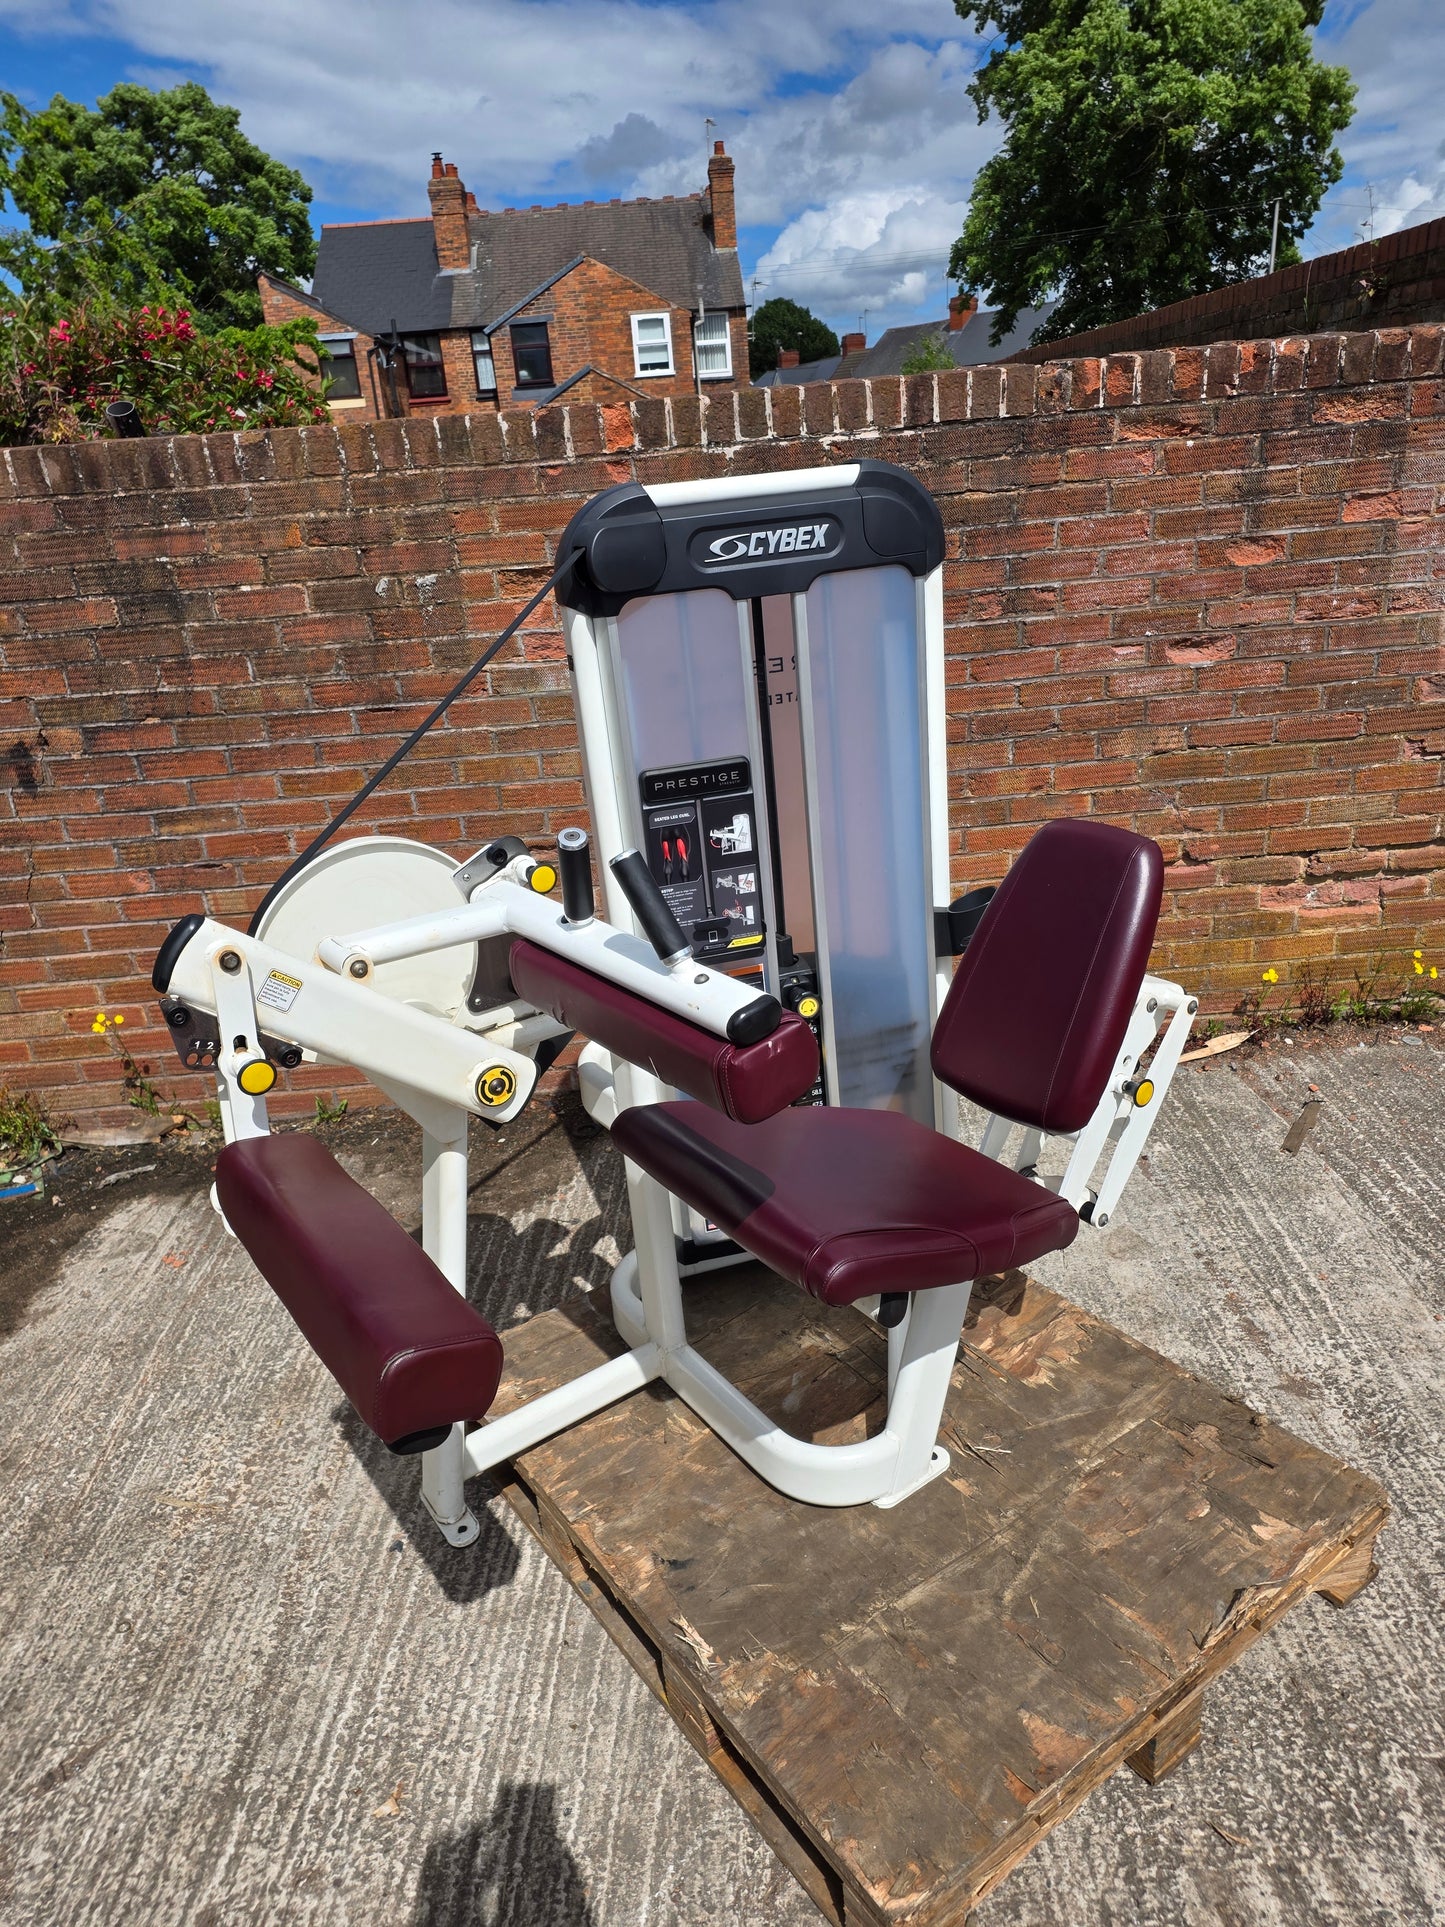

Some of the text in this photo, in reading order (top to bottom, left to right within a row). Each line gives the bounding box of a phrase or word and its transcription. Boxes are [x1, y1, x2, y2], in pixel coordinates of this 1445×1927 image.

[748, 524, 829, 556] CYBEX
[654, 771, 740, 791] PRESTIGE
[277, 975, 300, 987] CAUTION
[194, 1040, 214, 1050] 1 2
